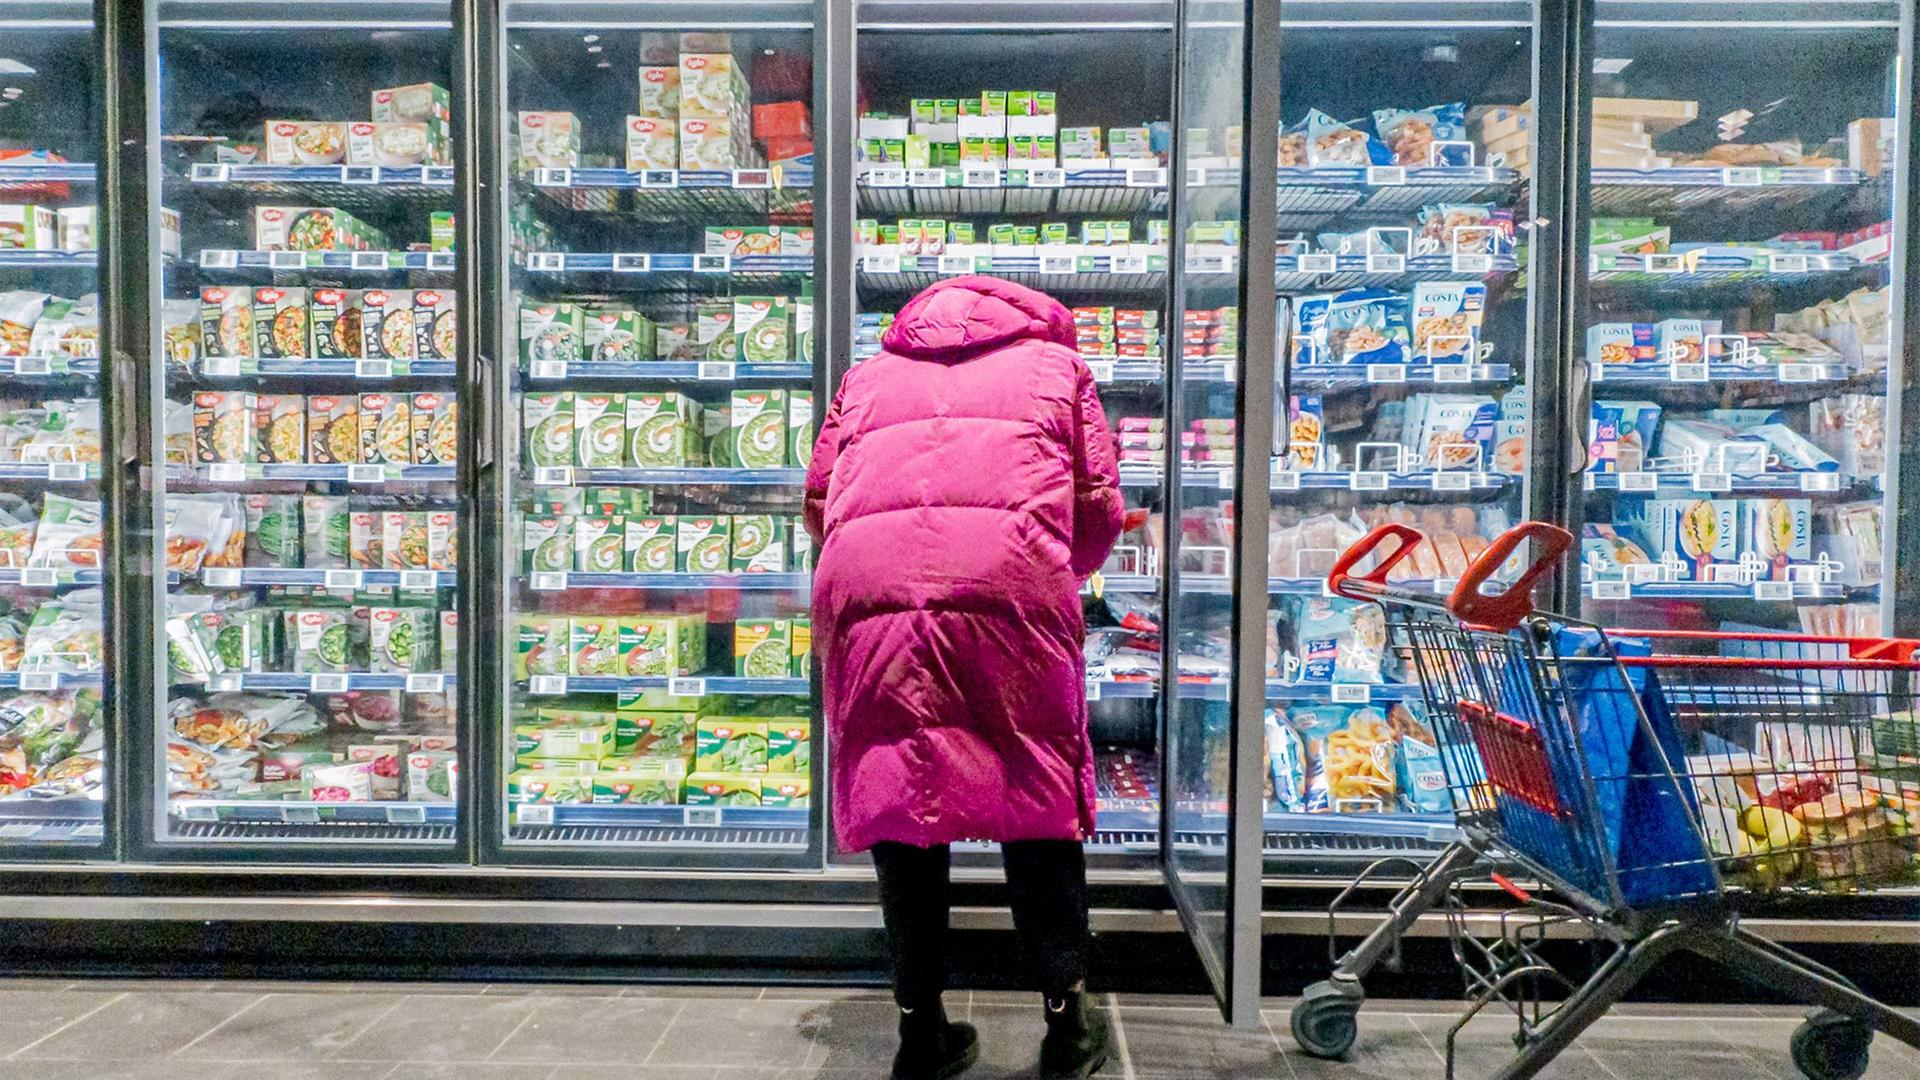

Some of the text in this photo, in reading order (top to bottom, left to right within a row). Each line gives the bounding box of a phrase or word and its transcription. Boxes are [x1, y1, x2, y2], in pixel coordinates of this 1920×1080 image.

[1425, 292, 1460, 302] COSTA
[1603, 328, 1631, 336] COSTA
[1673, 324, 1700, 332] COSTA
[1440, 409, 1473, 419] COSTA
[1720, 510, 1731, 549] COSTA
[1795, 510, 1807, 549] COSTA
[1417, 774, 1446, 784] COSTA
